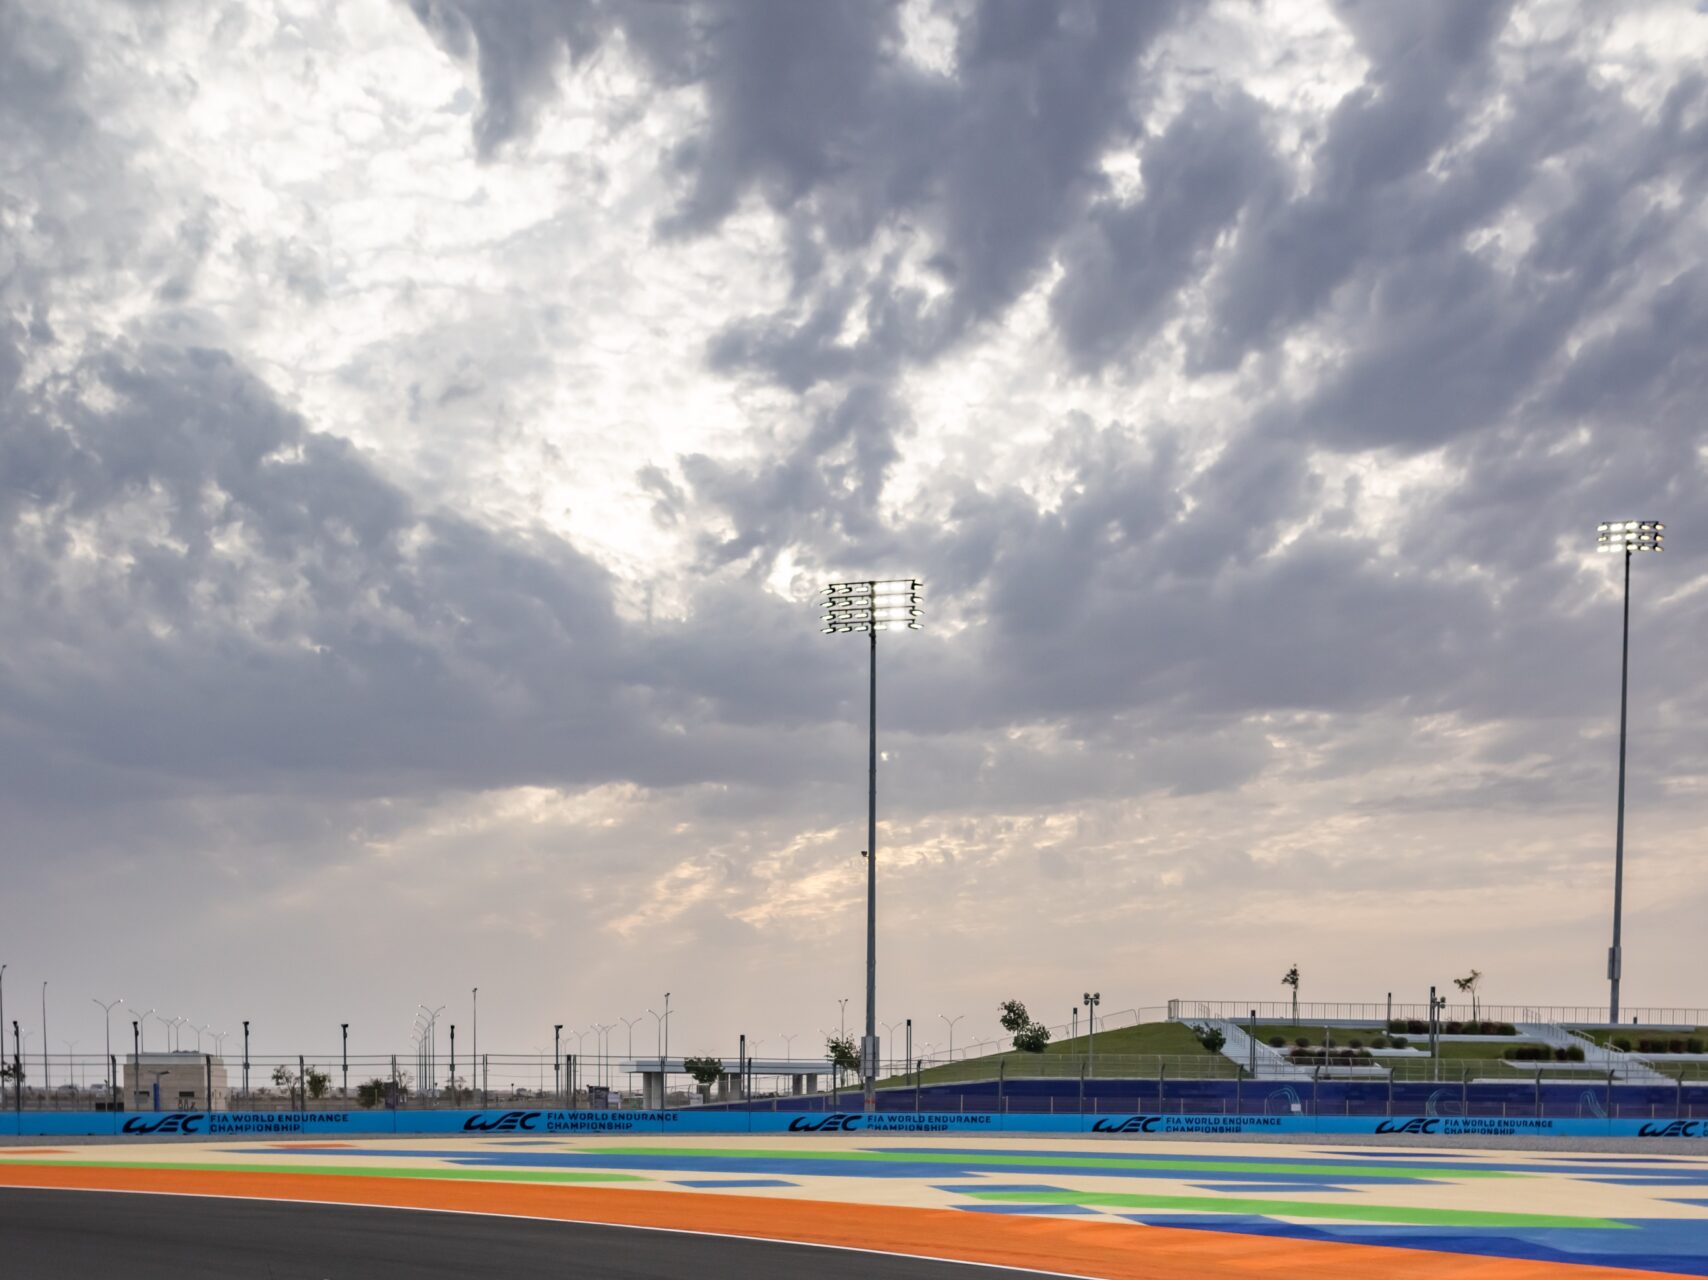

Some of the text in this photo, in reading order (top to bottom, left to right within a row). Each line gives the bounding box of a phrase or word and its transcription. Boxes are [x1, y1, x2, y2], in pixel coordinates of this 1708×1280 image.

[210, 1114, 349, 1123] FIA WORLD ENDURANCE
[463, 1112, 541, 1131] WEC
[547, 1112, 678, 1122] FIA WORLD ENDURANCE
[867, 1115, 992, 1124] FIA WORLD ENDURANCE
[1166, 1117, 1281, 1126] FIA WORLD ENDURANCE
[122, 1114, 204, 1134] WEC
[547, 1121, 632, 1130] CHAMPIONSHIP
[788, 1114, 862, 1132] WEC
[867, 1123, 948, 1131] CHAMPIONSHIP
[1092, 1116, 1161, 1132] WEC
[1375, 1118, 1440, 1134] WEC
[1444, 1119, 1553, 1128] FIA WORLD ENDURANCE
[210, 1124, 300, 1133] CHAMPIONSHIP
[1165, 1125, 1241, 1133] CHAMPIONSHIP
[1444, 1127, 1515, 1135] CHAMPIONSHIP
[1638, 1120, 1700, 1137] WEC
